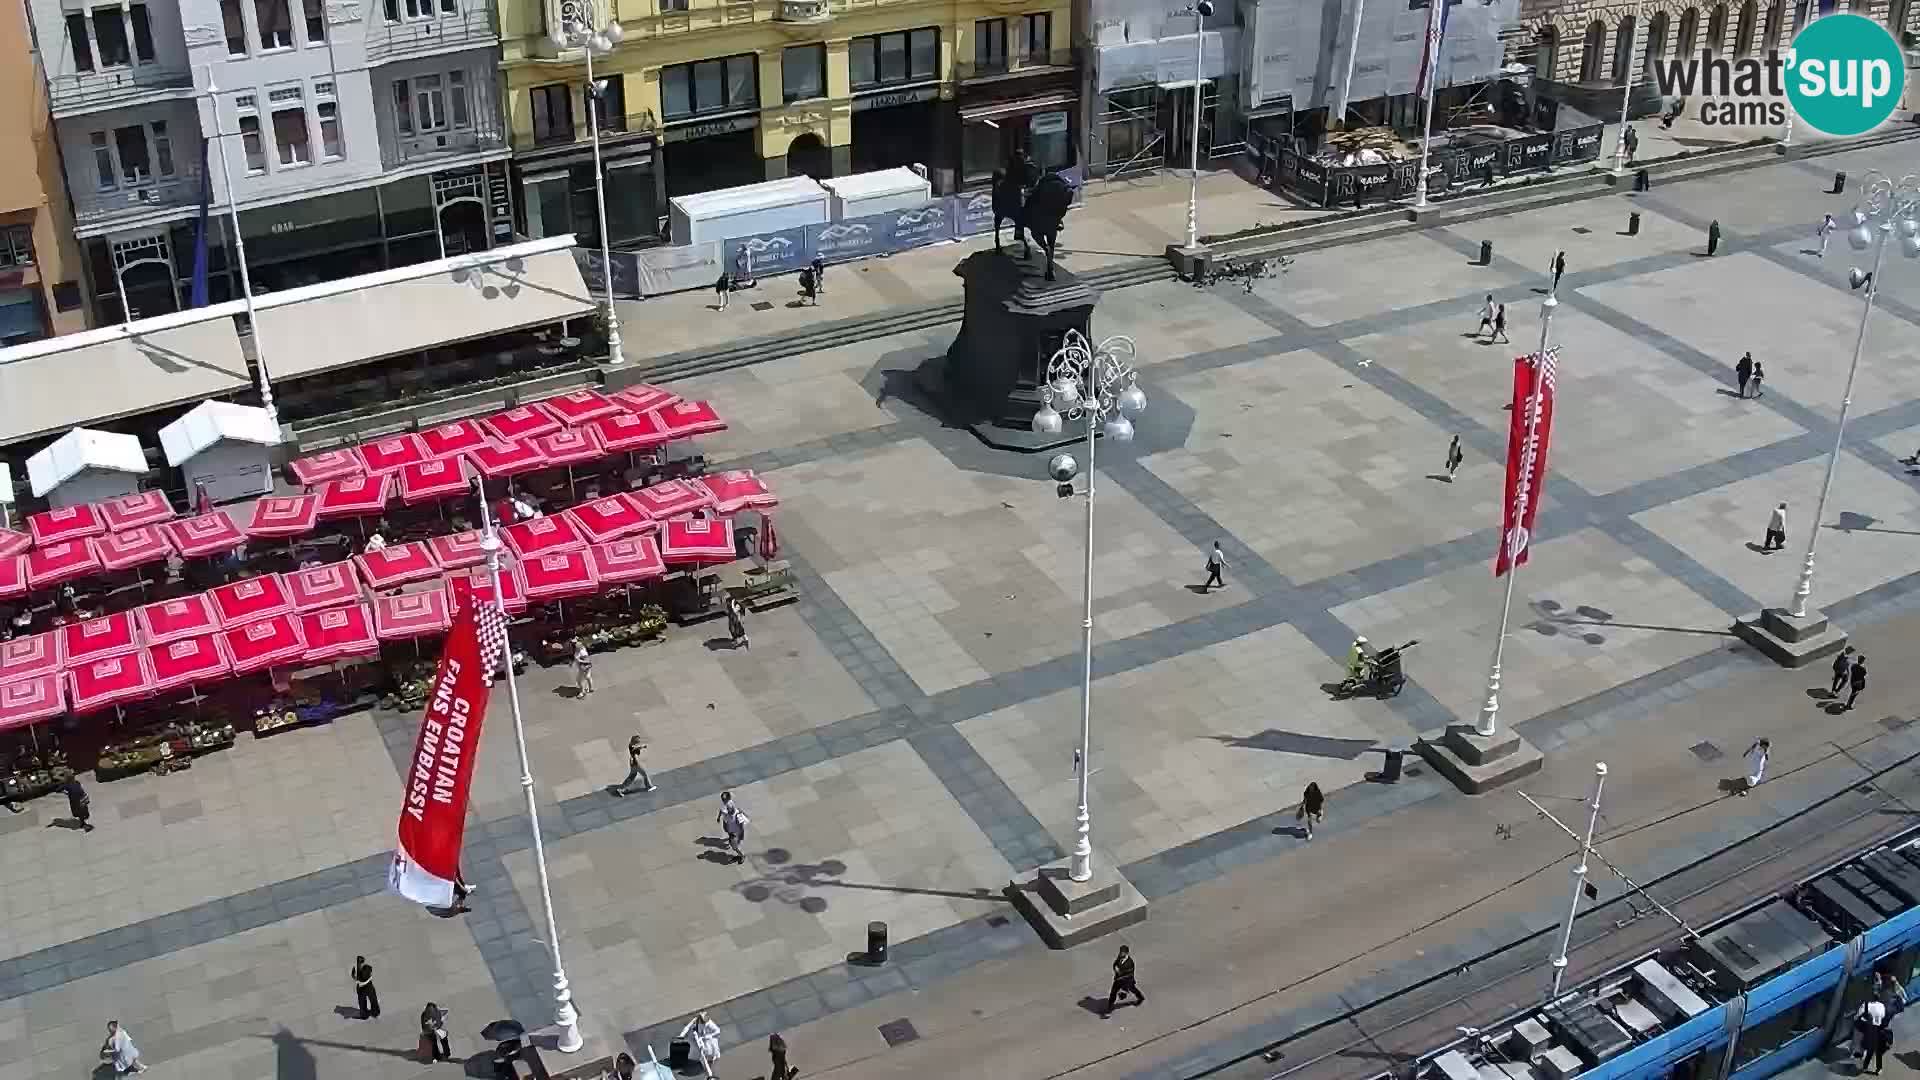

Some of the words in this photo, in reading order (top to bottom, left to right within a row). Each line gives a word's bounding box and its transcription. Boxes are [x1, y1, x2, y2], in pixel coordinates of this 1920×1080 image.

[433, 658, 461, 716] FANS
[407, 719, 443, 822] EMBASSY
[433, 697, 470, 804] CROATIAN
